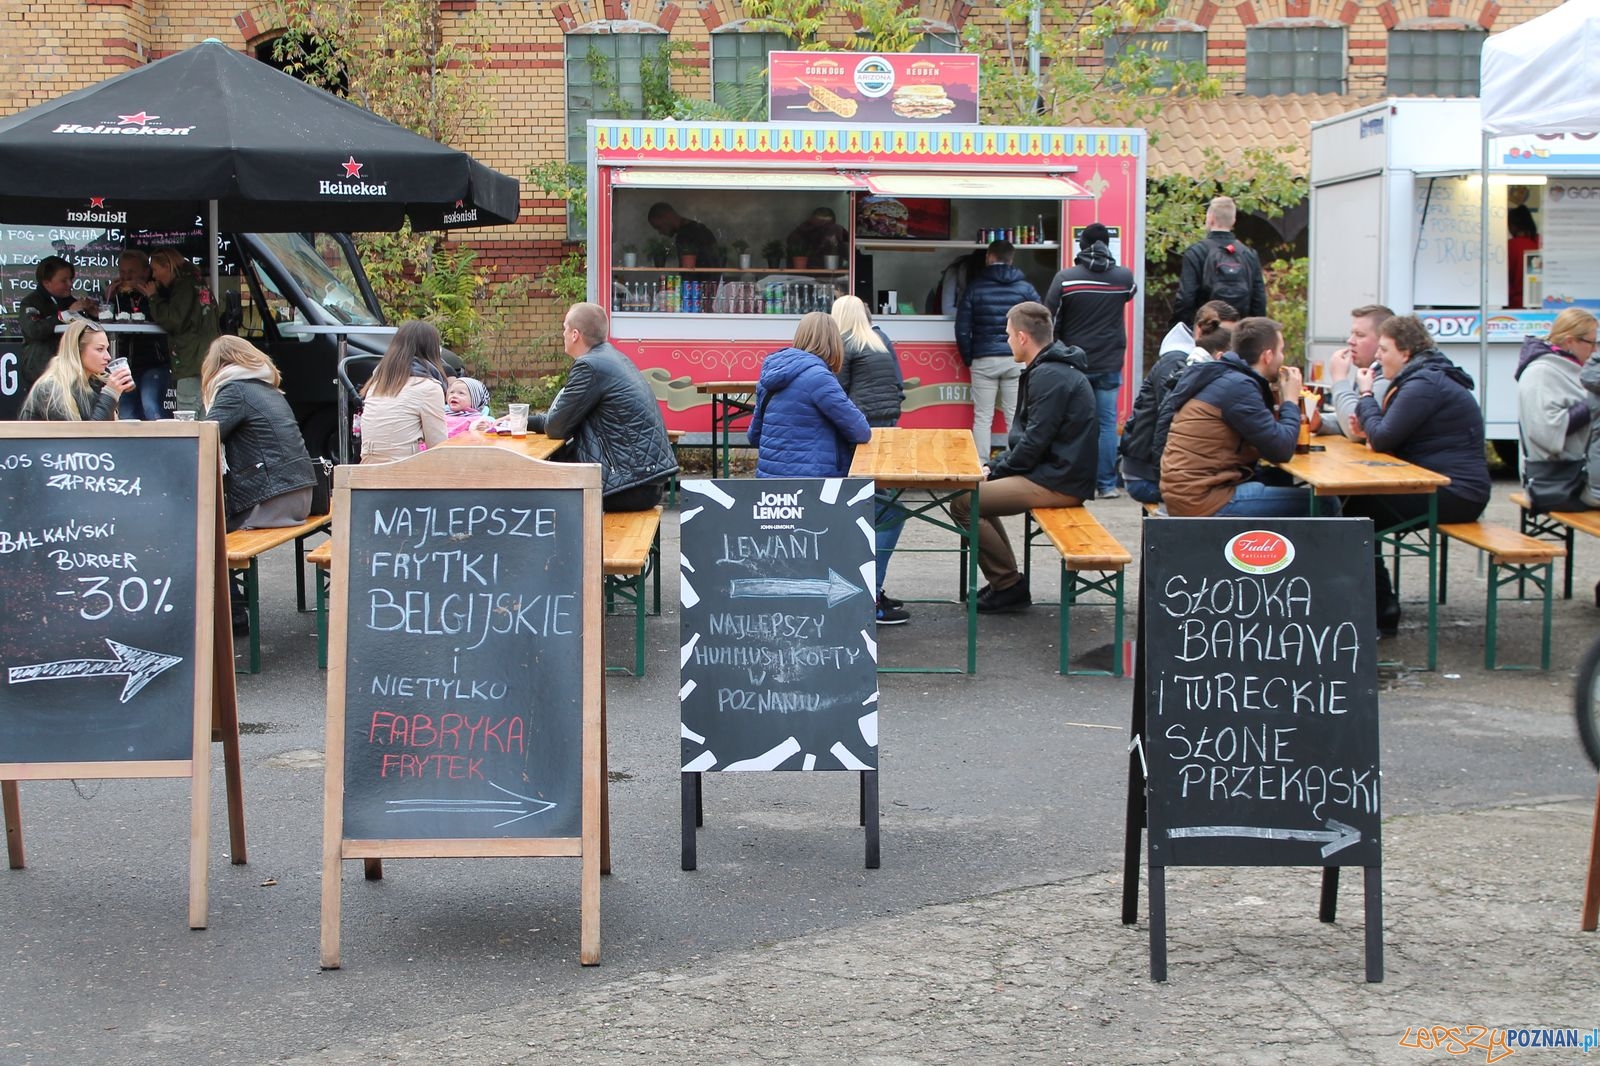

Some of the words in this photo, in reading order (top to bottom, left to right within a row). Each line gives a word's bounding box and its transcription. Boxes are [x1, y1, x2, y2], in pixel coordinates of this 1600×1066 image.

[52, 124, 192, 136] Heineken
[319, 180, 388, 196] Heineken
[7, 229, 35, 241] FOG
[48, 228, 100, 241] GRUCHA
[9, 278, 38, 290] FOG
[1423, 317, 1475, 336] ODY
[40, 452, 116, 472] SANTOS
[46, 473, 142, 497] ZAPRASZA
[756, 490, 799, 507] JOHN
[752, 504, 803, 520] LEMON
[373, 506, 557, 549] NAJLEPSZE
[715, 527, 829, 565] LEWANT
[1238, 539, 1282, 552] Tudel
[47, 550, 138, 573] BURGER
[371, 550, 499, 586] FRYTKI
[56, 576, 174, 621] -30%
[1158, 574, 1312, 619] SŁODKA
[366, 588, 575, 650] BELGIJSKIE
[708, 612, 826, 641] NAJLEPSZY
[694, 645, 772, 667] HUMMUS
[790, 645, 861, 670] KOFTY
[1174, 618, 1360, 674] BAKLAVA
[747, 667, 767, 686] W
[718, 687, 821, 714] POZNANIU
[368, 711, 524, 755] FABRYKA
[1165, 723, 1298, 764] SŁONE
[380, 754, 485, 780] FRYTEK
